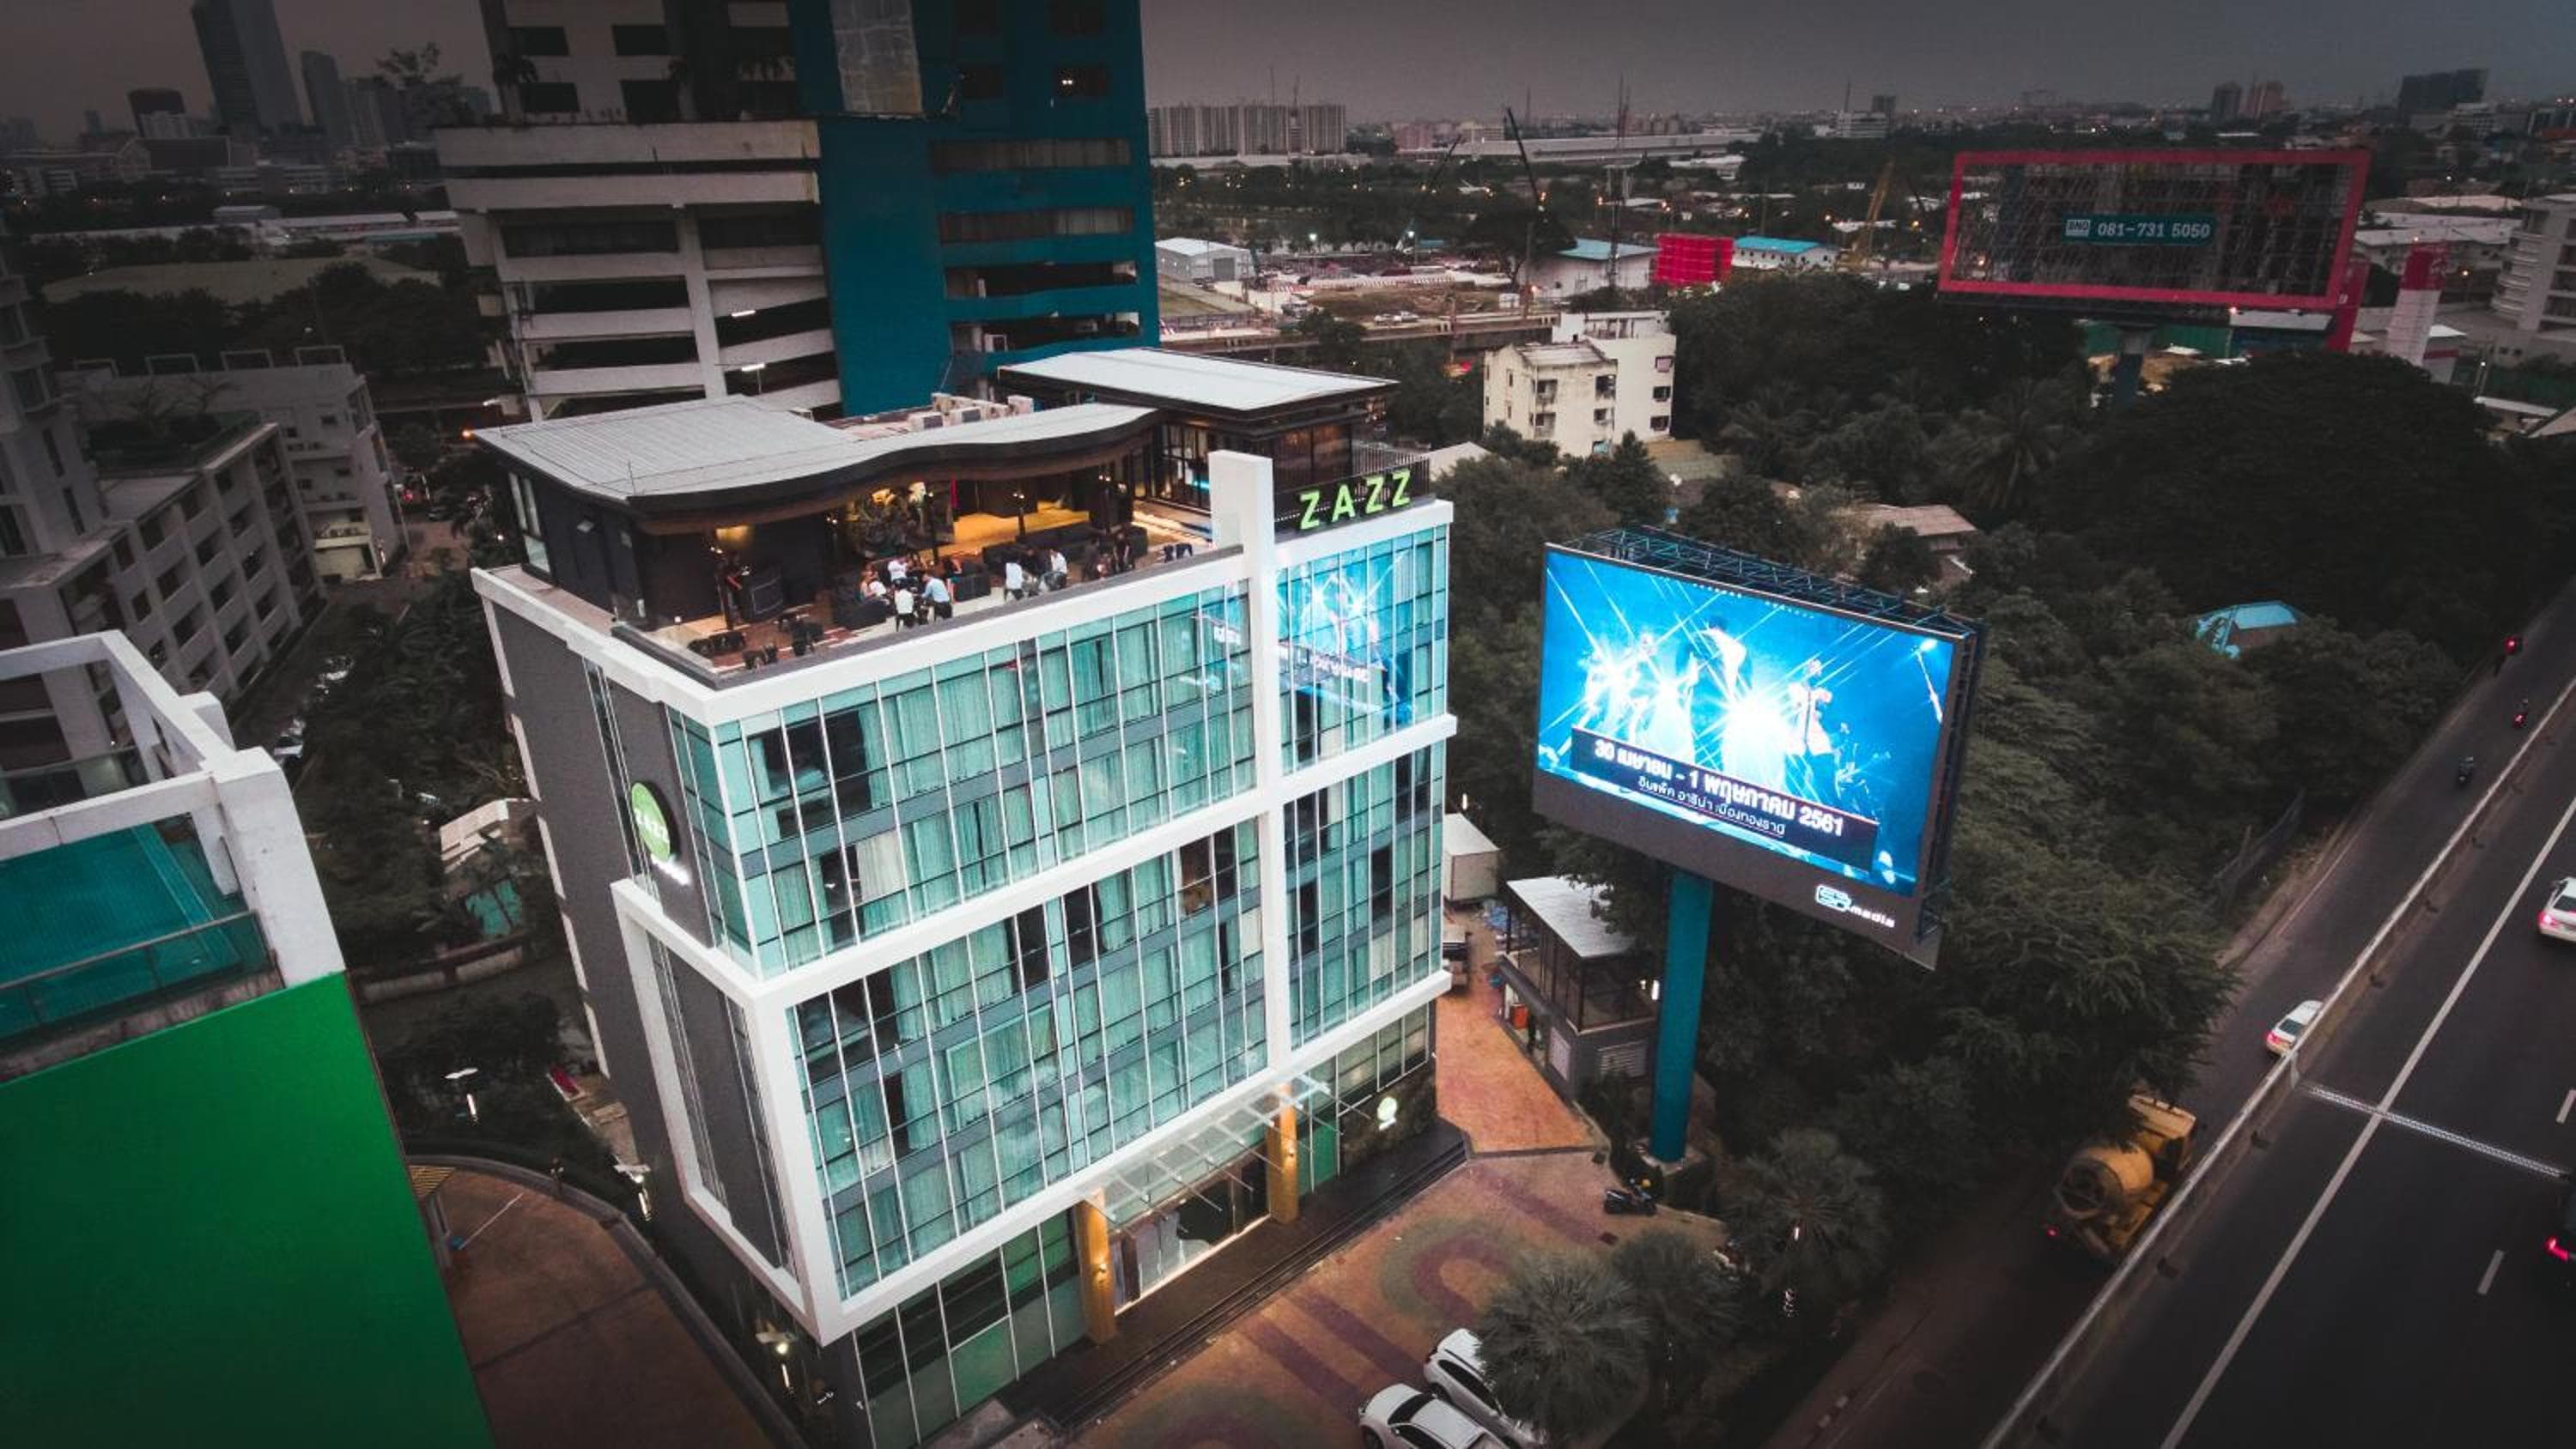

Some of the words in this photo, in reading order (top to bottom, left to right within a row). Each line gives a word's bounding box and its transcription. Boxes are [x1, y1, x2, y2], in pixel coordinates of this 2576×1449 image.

[2098, 222, 2165, 238] 081-731
[2172, 223, 2211, 239] 5050
[1299, 470, 1411, 530] ZAZZ
[1595, 739, 1614, 761] 30
[1617, 748, 1673, 780] เมษายน
[1689, 770, 1699, 789] 1
[1704, 773, 1796, 821] พฤษภาคม
[1799, 806, 1844, 837] 2561
